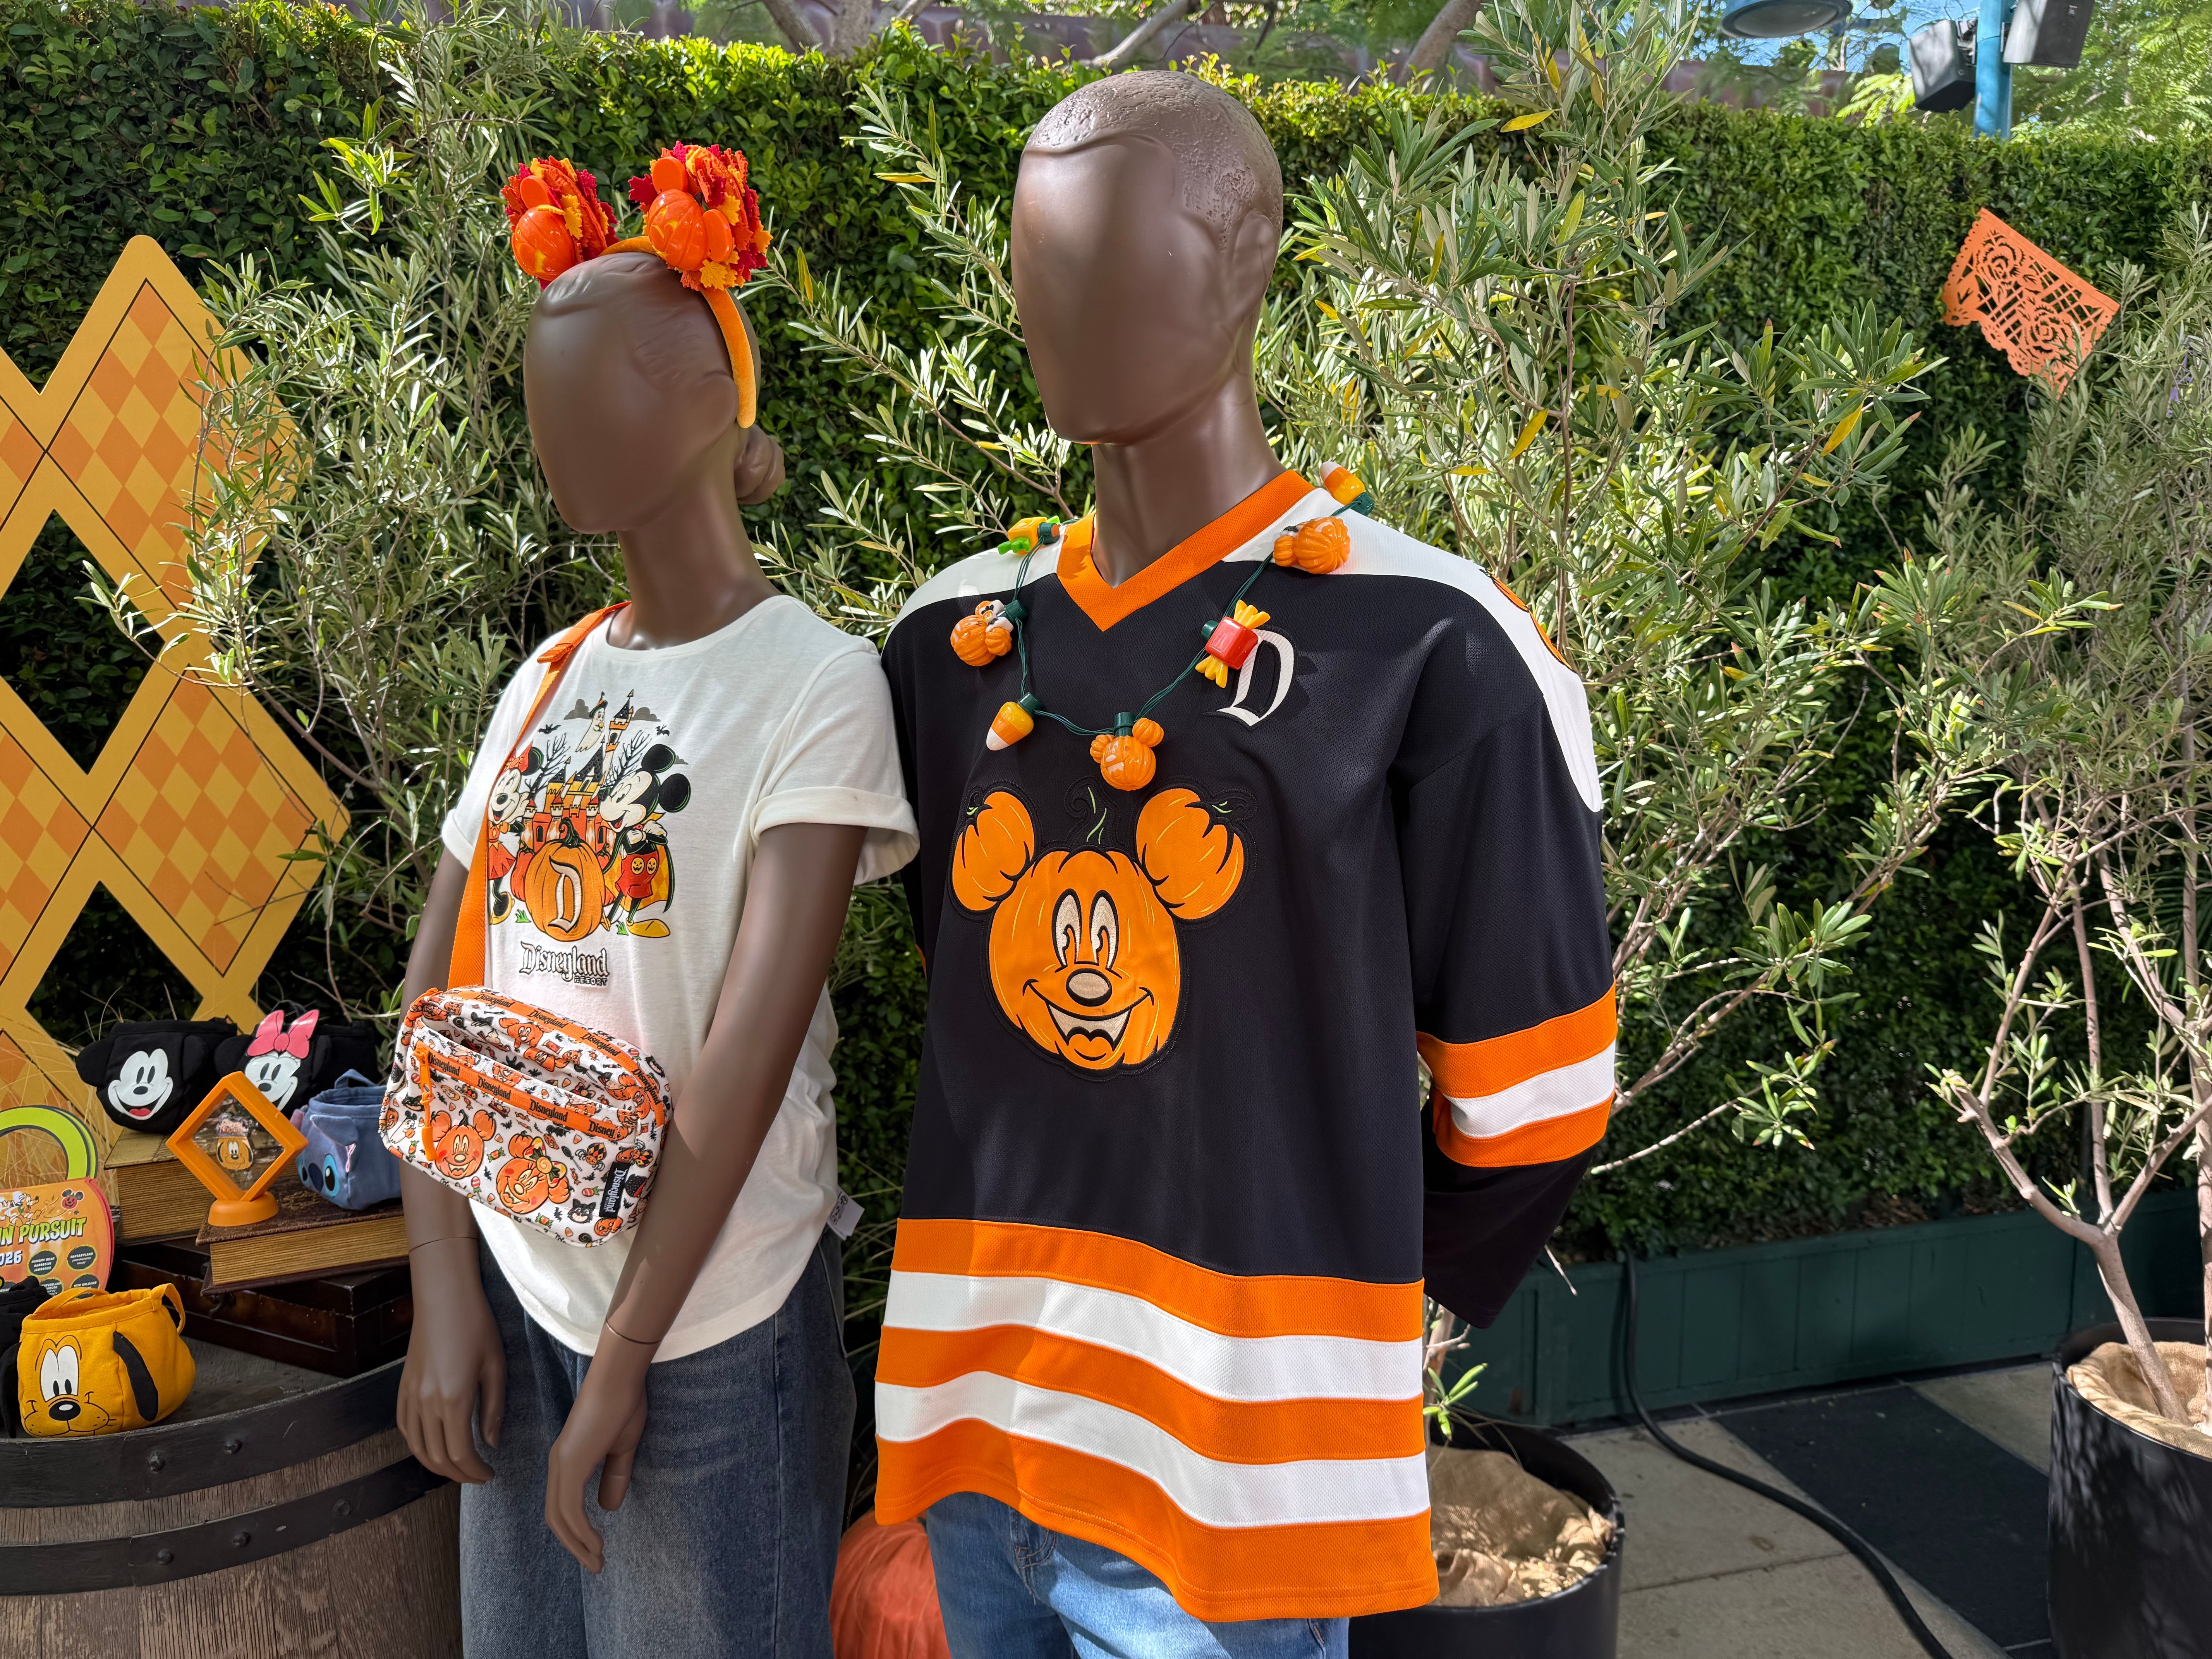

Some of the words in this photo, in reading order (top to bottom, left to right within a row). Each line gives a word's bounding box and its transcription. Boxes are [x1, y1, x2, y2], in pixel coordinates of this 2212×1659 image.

[1215, 626, 1295, 728] D
[547, 855, 583, 934] D
[519, 941, 610, 982] Disneyland
[574, 975, 608, 986] RESORT
[474, 994, 515, 1007] Disneyland
[527, 1010, 569, 1029] Disneyland
[580, 1032, 621, 1056] Disneyland
[632, 1069, 661, 1105] Disneyland
[428, 1051, 460, 1076] Disneyland
[478, 1076, 511, 1101] Disneyland
[529, 1098, 568, 1122] Disneyland
[605, 1168, 628, 1212] Disneyland
[18, 1217, 87, 1244] PURSUIT
